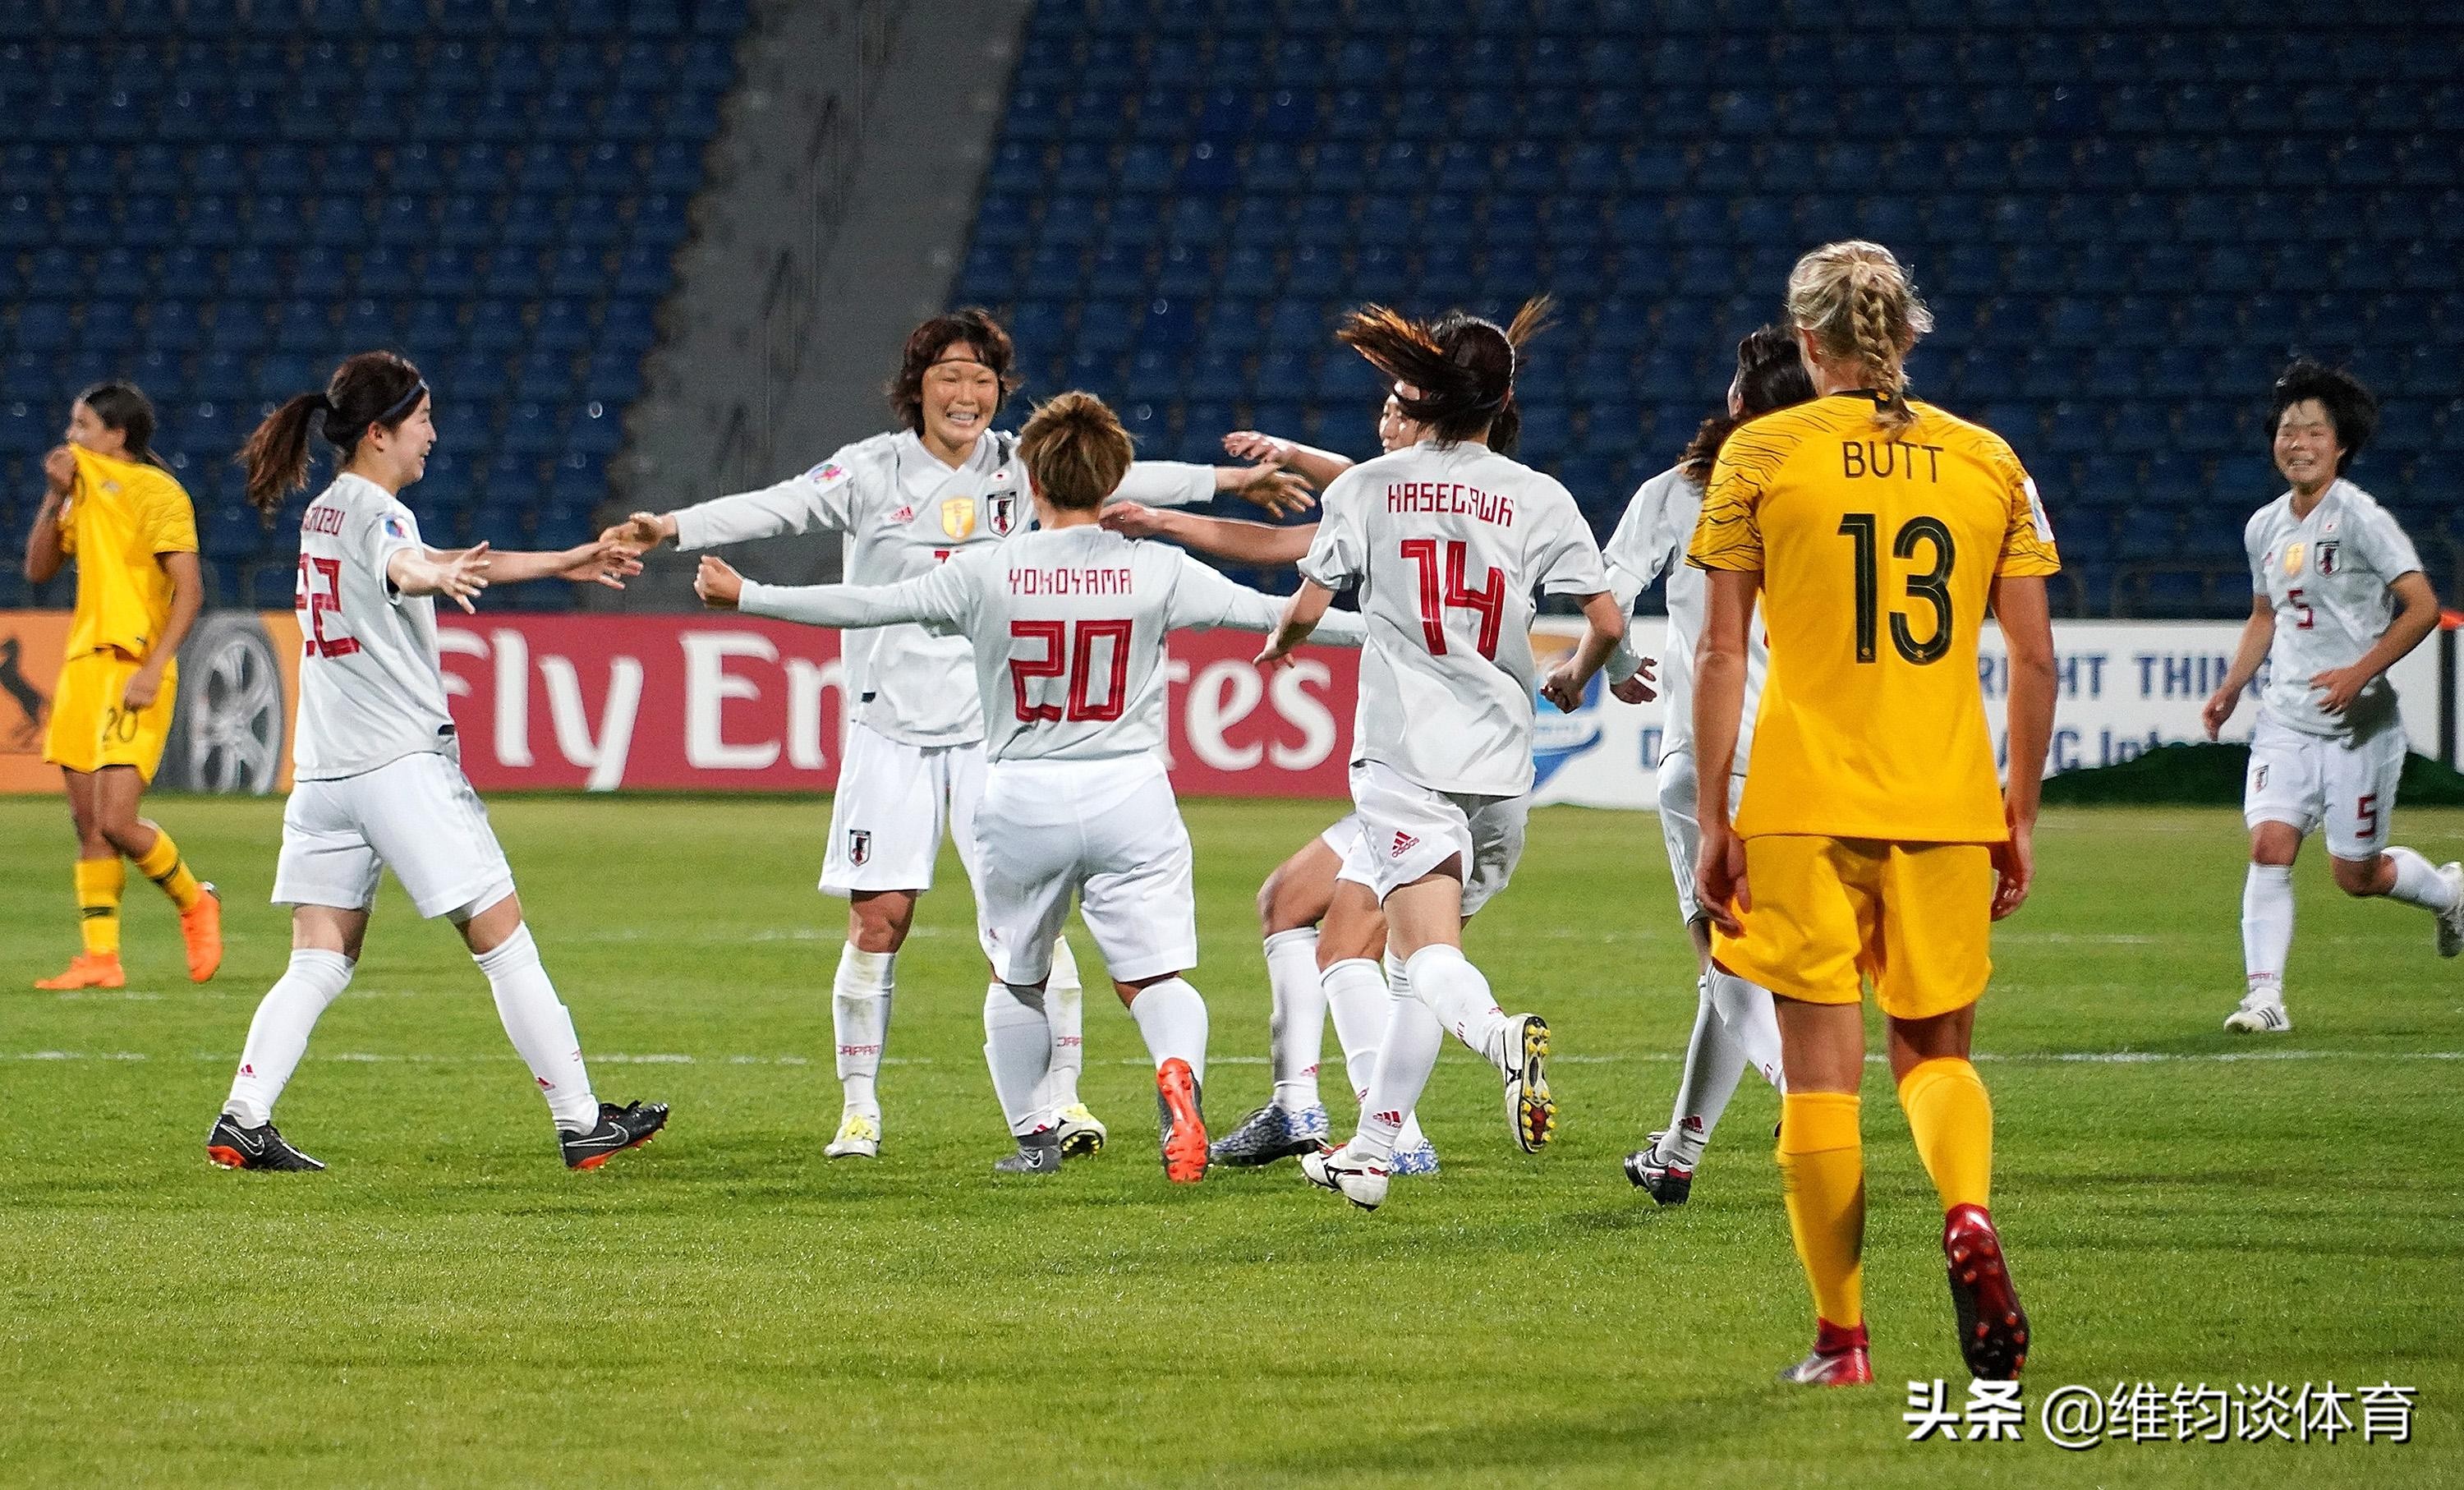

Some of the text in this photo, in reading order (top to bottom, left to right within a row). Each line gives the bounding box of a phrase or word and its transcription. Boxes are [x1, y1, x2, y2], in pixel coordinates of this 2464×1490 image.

[1842, 440, 1944, 483] BUTT
[1388, 483, 1515, 527] HASEGAWA
[1009, 568, 1133, 596] YOKOYAMA
[1400, 539, 1506, 661] 14
[1837, 513, 1956, 666] 13
[2287, 587, 2315, 630] 5
[1009, 619, 1133, 723] 20
[1979, 651, 2109, 697] RIHT
[103, 706, 138, 743] 20
[2355, 793, 2377, 839] 5
[1391, 837, 1419, 858] adidas
